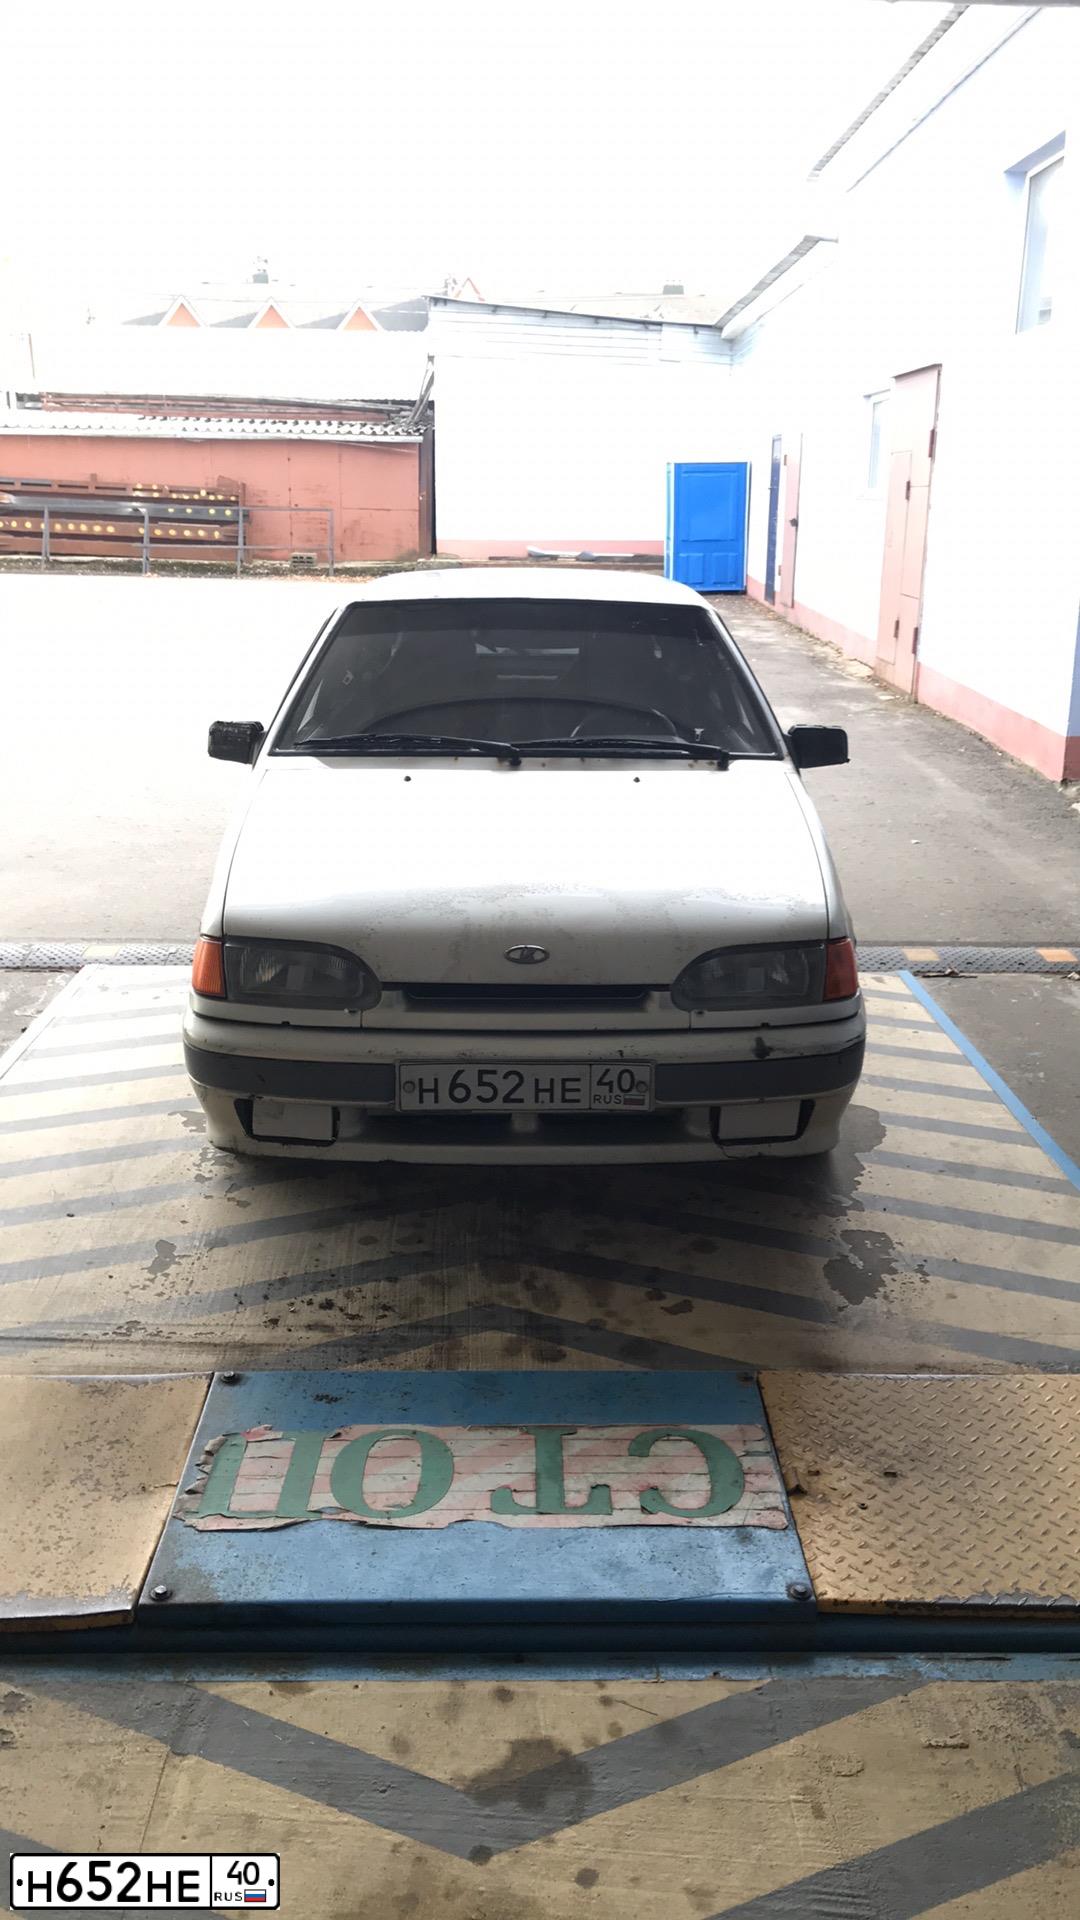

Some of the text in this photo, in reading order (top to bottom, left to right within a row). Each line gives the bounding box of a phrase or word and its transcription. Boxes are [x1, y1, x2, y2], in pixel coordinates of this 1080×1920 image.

[596, 1068, 636, 1094] 40
[593, 1094, 622, 1105] RUS
[199, 1427, 746, 1519] СТОП
